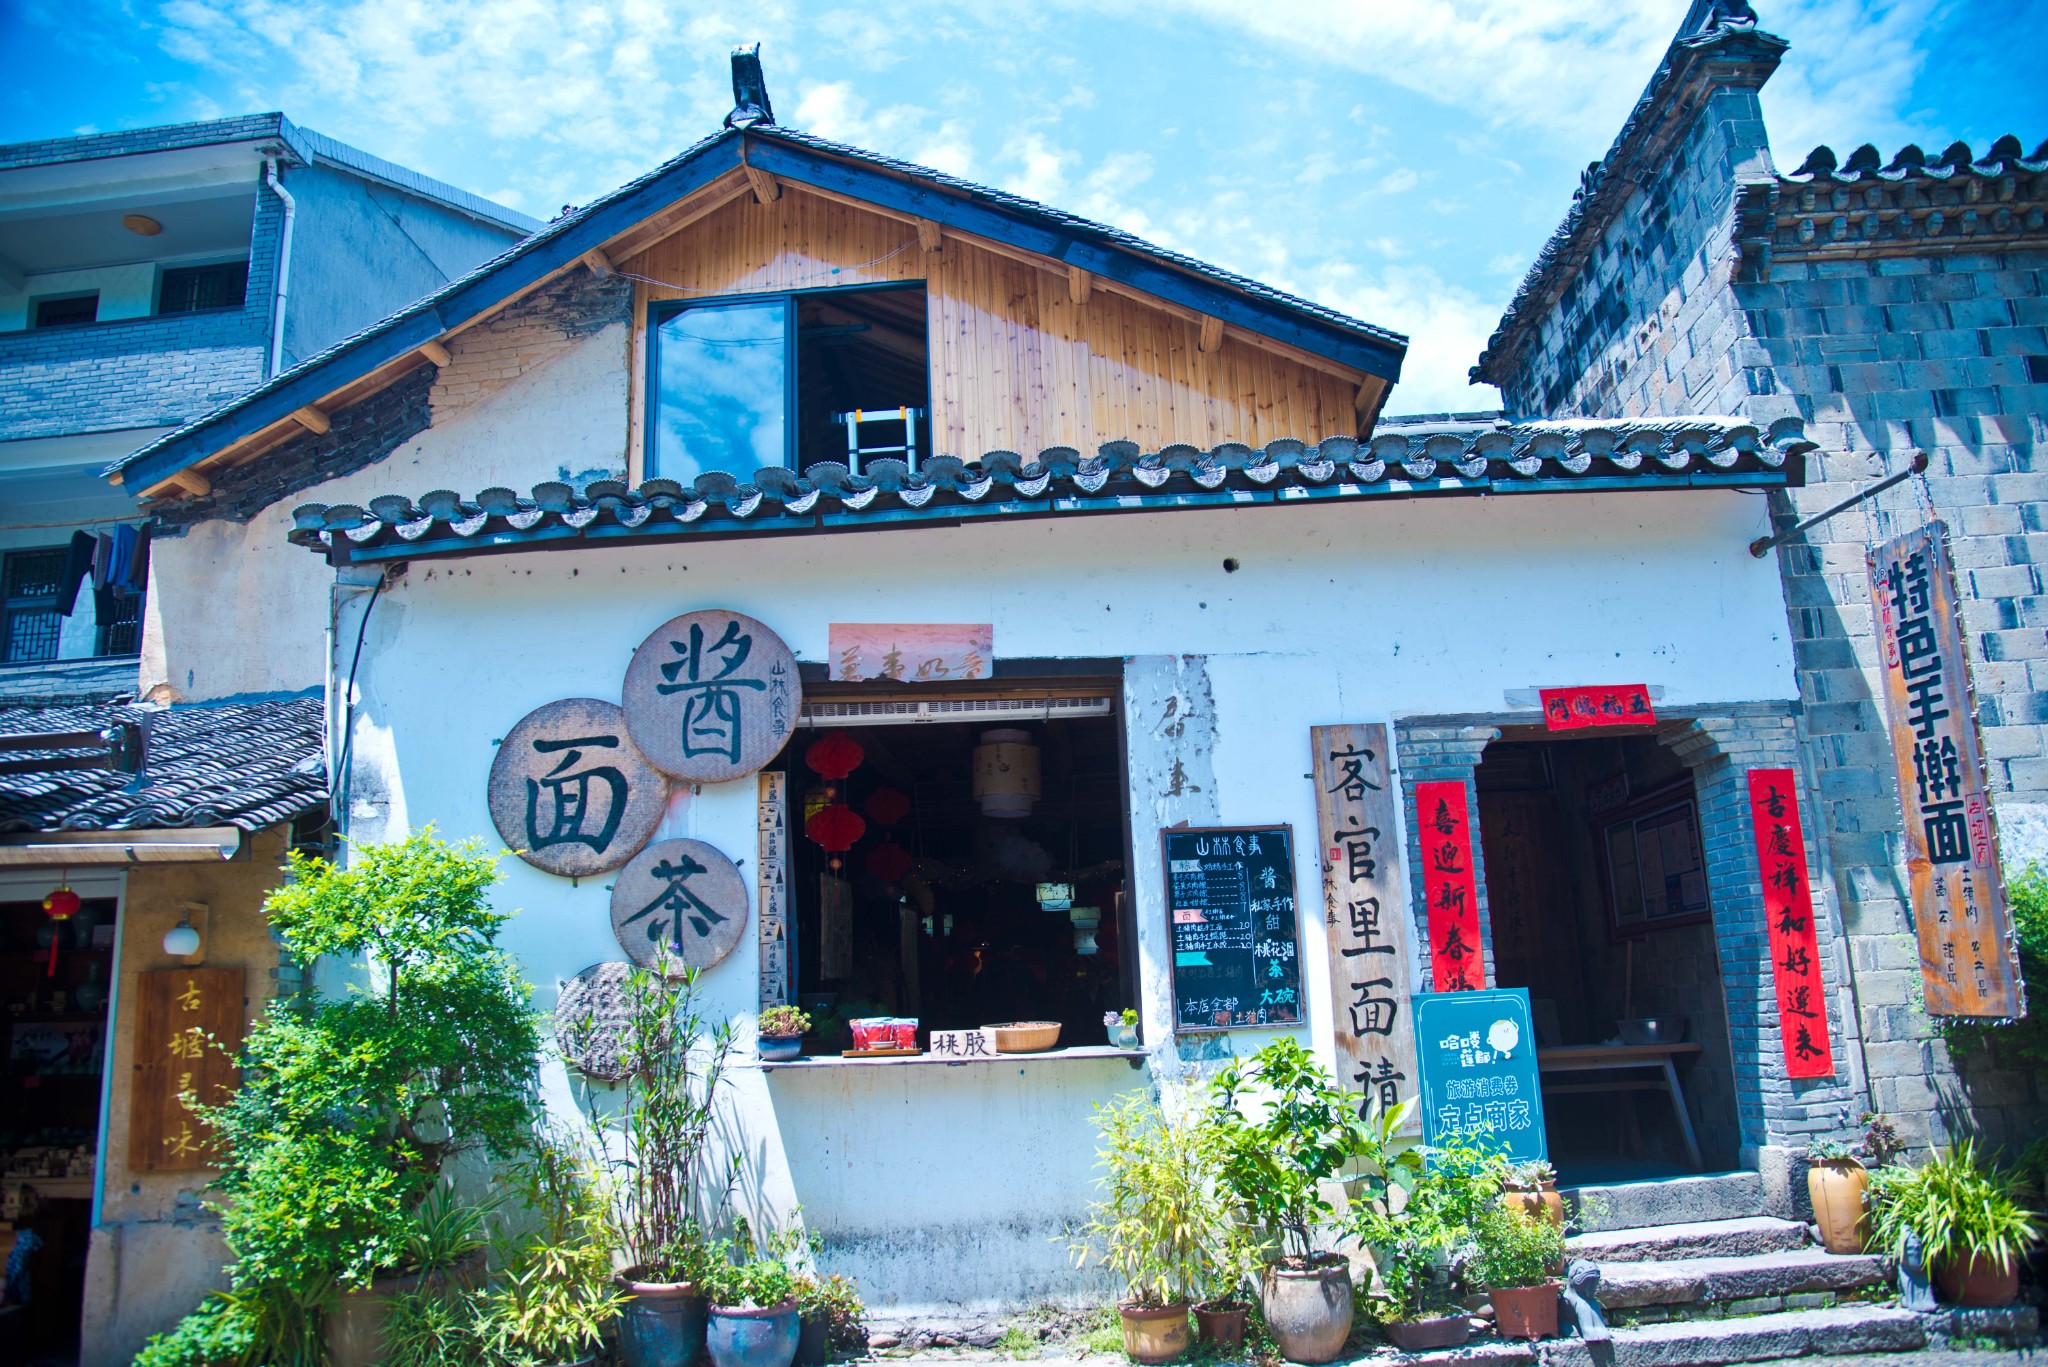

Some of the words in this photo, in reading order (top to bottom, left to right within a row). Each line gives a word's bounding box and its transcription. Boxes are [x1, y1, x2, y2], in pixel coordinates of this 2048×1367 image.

[656, 620, 767, 765] 酱
[769, 659, 792, 740] 山林食事
[1887, 552, 1972, 865] 特色手擀面
[526, 735, 629, 855] 面
[1196, 834, 1263, 857] 山林食事
[620, 854, 730, 957] 茶
[1250, 896, 1294, 912] 私家手作
[1323, 860, 1341, 928] 山林食事
[1265, 914, 1280, 930] 甜
[1327, 744, 1406, 1122] 客官里面请
[1268, 958, 1284, 978] 茶
[1184, 996, 1239, 1015] 本店全部
[1260, 988, 1296, 1005] 大碗
[932, 1031, 993, 1057] 桃胶
[1446, 1075, 1519, 1100] 旅游消费券
[1438, 1098, 1532, 1136] 定点商家
